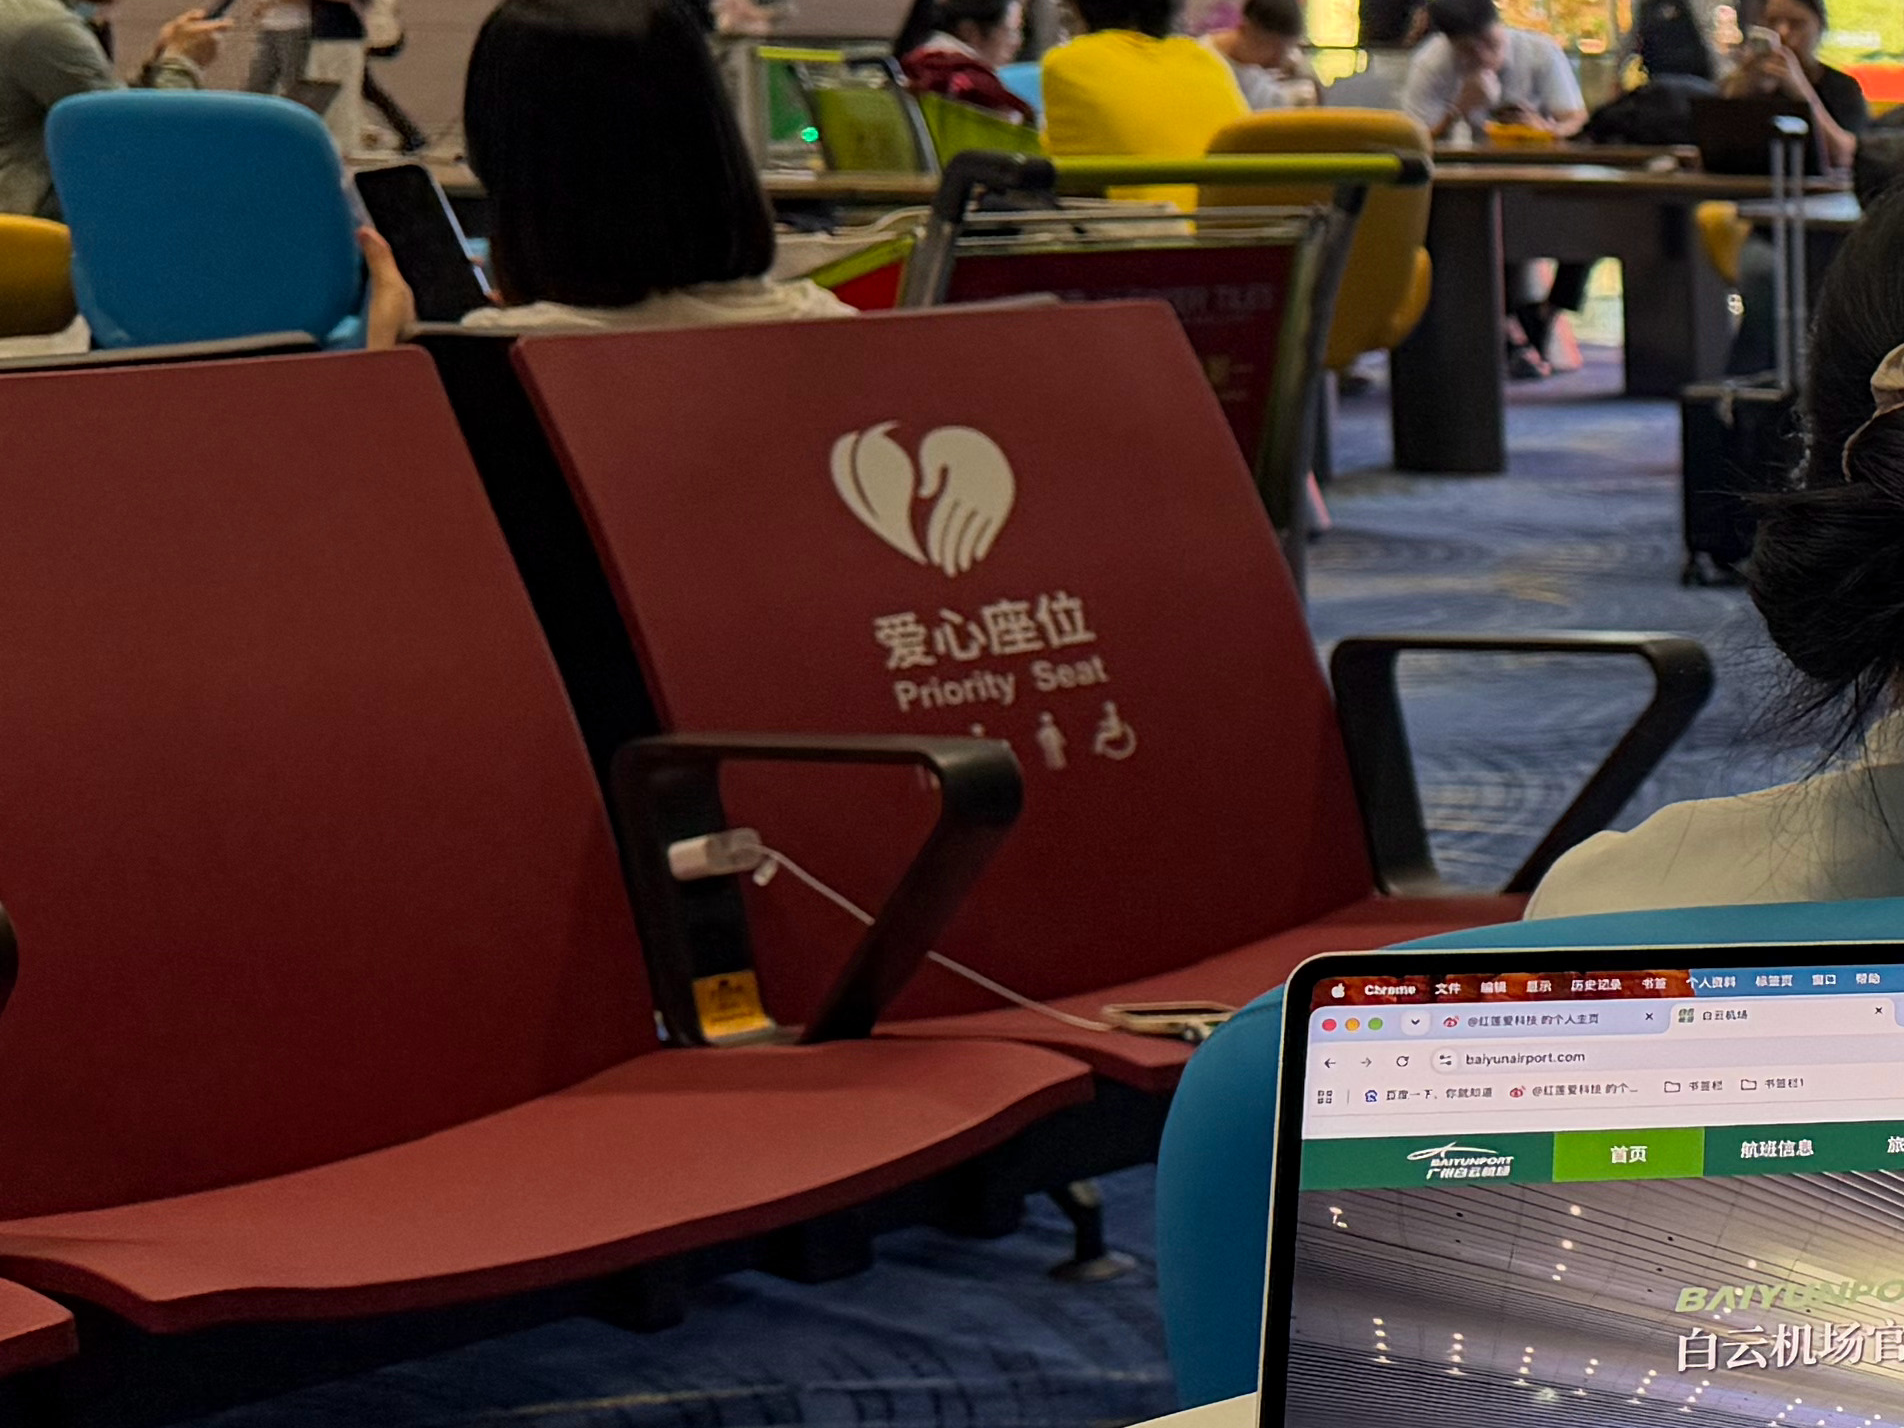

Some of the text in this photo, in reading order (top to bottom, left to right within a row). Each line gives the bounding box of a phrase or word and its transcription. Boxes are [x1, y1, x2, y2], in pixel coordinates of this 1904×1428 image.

[873, 591, 1096, 670] 爱心座位
[893, 655, 1110, 712] Priority Seat
[1364, 983, 1416, 996] Chrome
[1435, 981, 1462, 995] 文件
[1570, 977, 1622, 992] 历史记录
[1541, 1012, 1599, 1026] 的个人主页
[1465, 1051, 1586, 1067] baiyunairport.com
[1610, 1145, 1648, 1164] 首页
[1740, 1139, 1814, 1159] 航班信息
